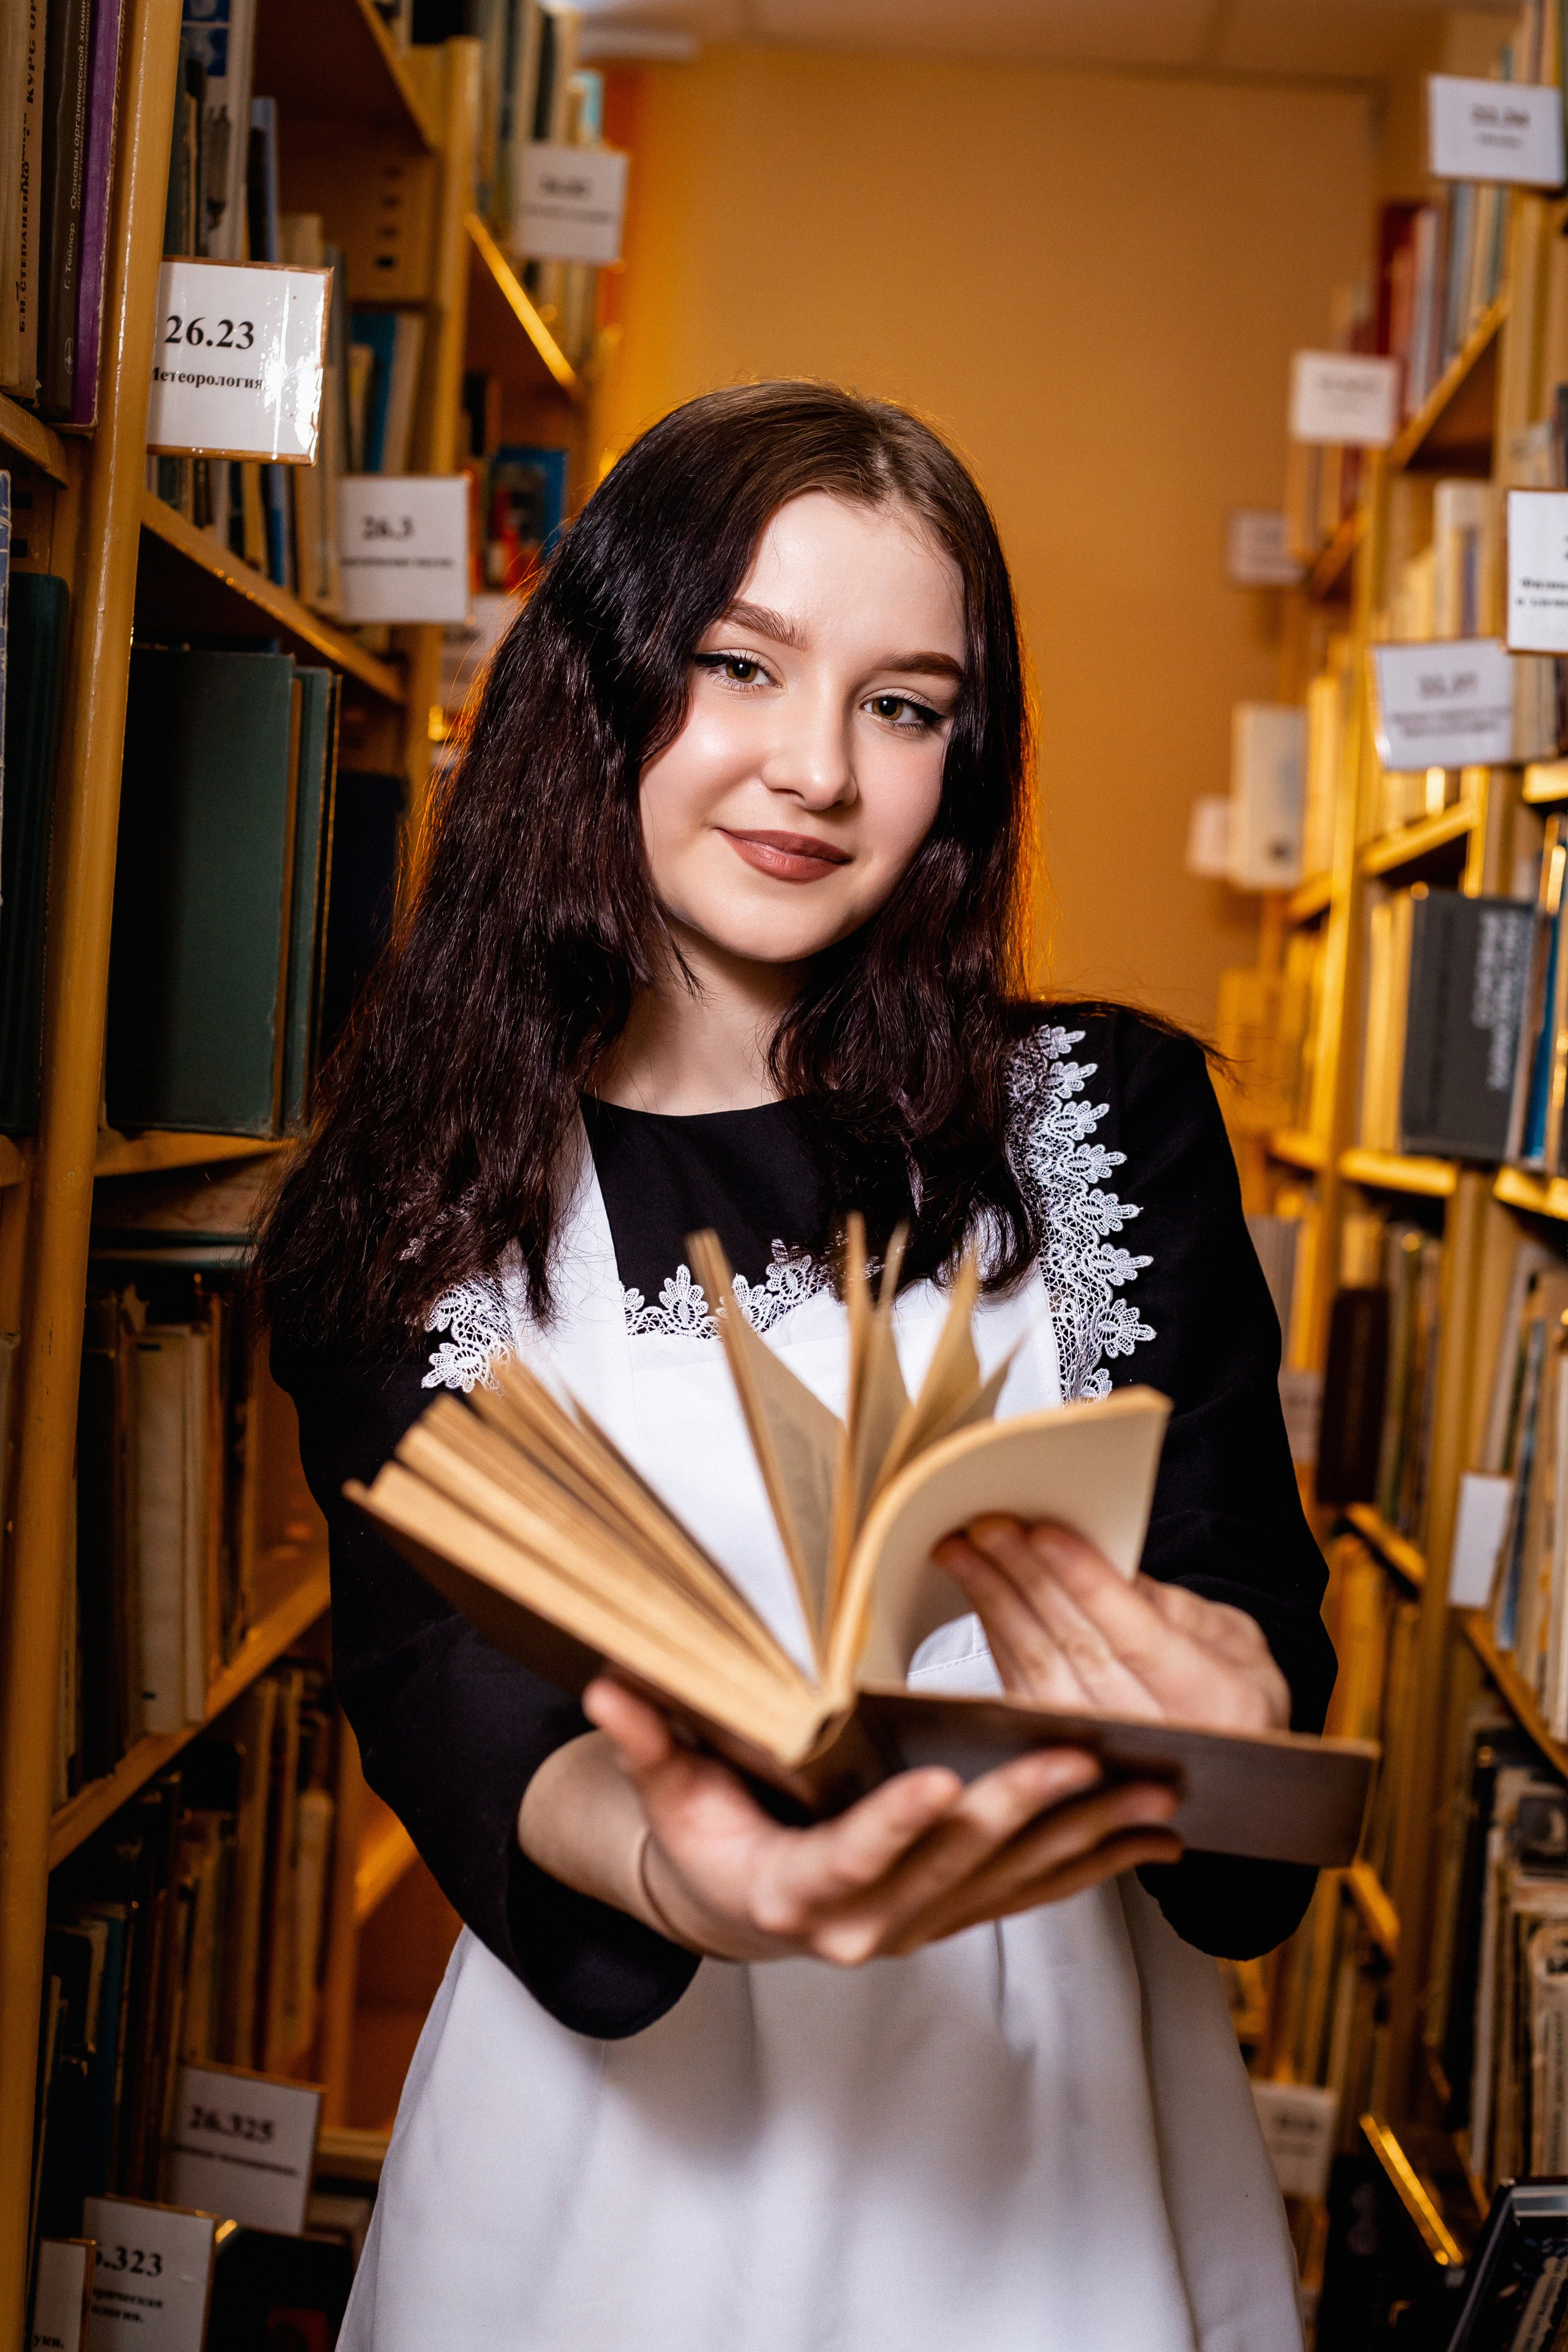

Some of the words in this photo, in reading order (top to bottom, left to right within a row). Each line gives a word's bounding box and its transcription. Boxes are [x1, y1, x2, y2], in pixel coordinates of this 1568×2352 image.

[26, 39, 36, 104] КУРС
[74, 45, 84, 147] органической
[70, 149, 79, 209] Основы
[65, 222, 76, 274] Тейлор
[164, 315, 254, 350] 26.23
